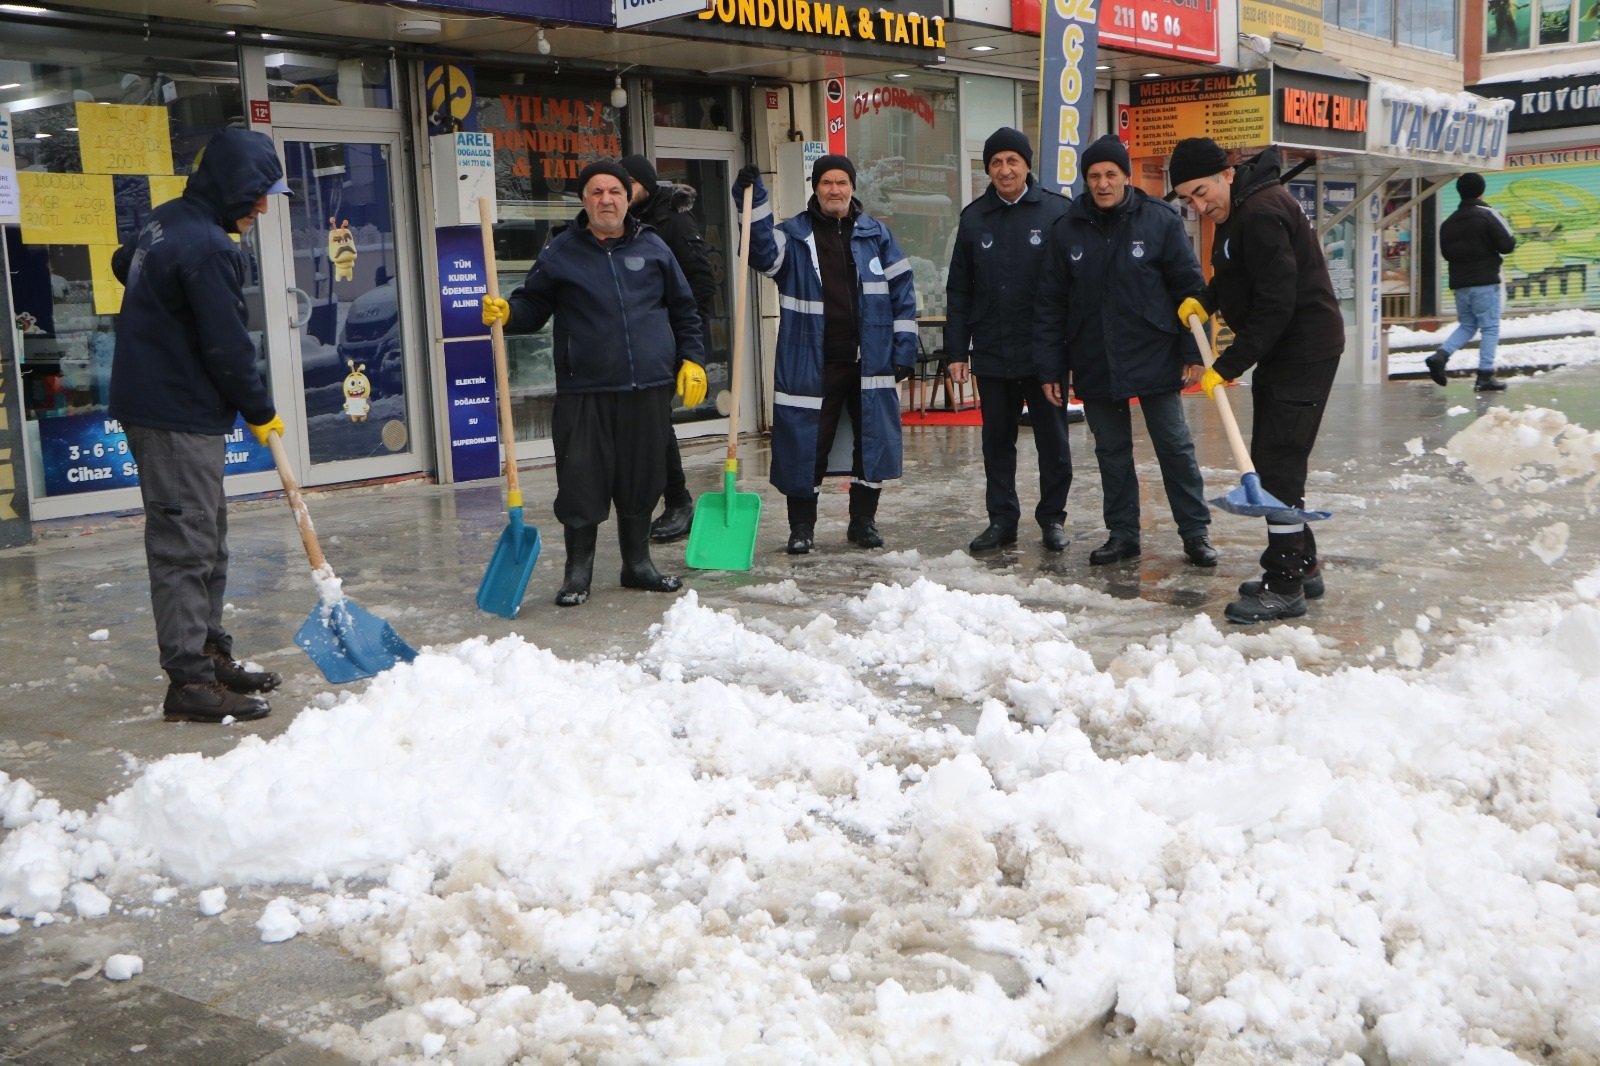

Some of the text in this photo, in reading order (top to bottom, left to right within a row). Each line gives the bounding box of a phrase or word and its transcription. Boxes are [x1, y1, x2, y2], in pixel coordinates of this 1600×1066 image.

[859, 8, 875, 39] &
[881, 11, 946, 48] TATLI
[1113, 5, 1181, 37] 211 05 06
[1140, 73, 1257, 98] MERKEZ EMLAK
[853, 90, 870, 120] ÖZ
[1165, 94, 1197, 104] MENKUL
[500, 94, 606, 128] YILMAZ
[1284, 87, 1367, 132] MERKEZ EMLAK
[830, 116, 844, 134] ÖZ
[1390, 100, 1505, 158] VANGÖLÜ
[457, 133, 492, 147] AREL
[512, 156, 531, 177] &
[453, 259, 472, 270] TÜM
[448, 273, 477, 283] KURUM
[442, 284, 487, 295] ÖDEMELERİ
[452, 299, 479, 309] ALINIR
[454, 395, 491, 406] DOĞALGAZ
[468, 417, 478, 425] SU
[452, 435, 497, 447] SUPERONLINE
[69, 446, 81, 461] 3
[93, 443, 105, 459] 6
[117, 440, 129, 455] 9
[67, 466, 112, 483] Cihaz
